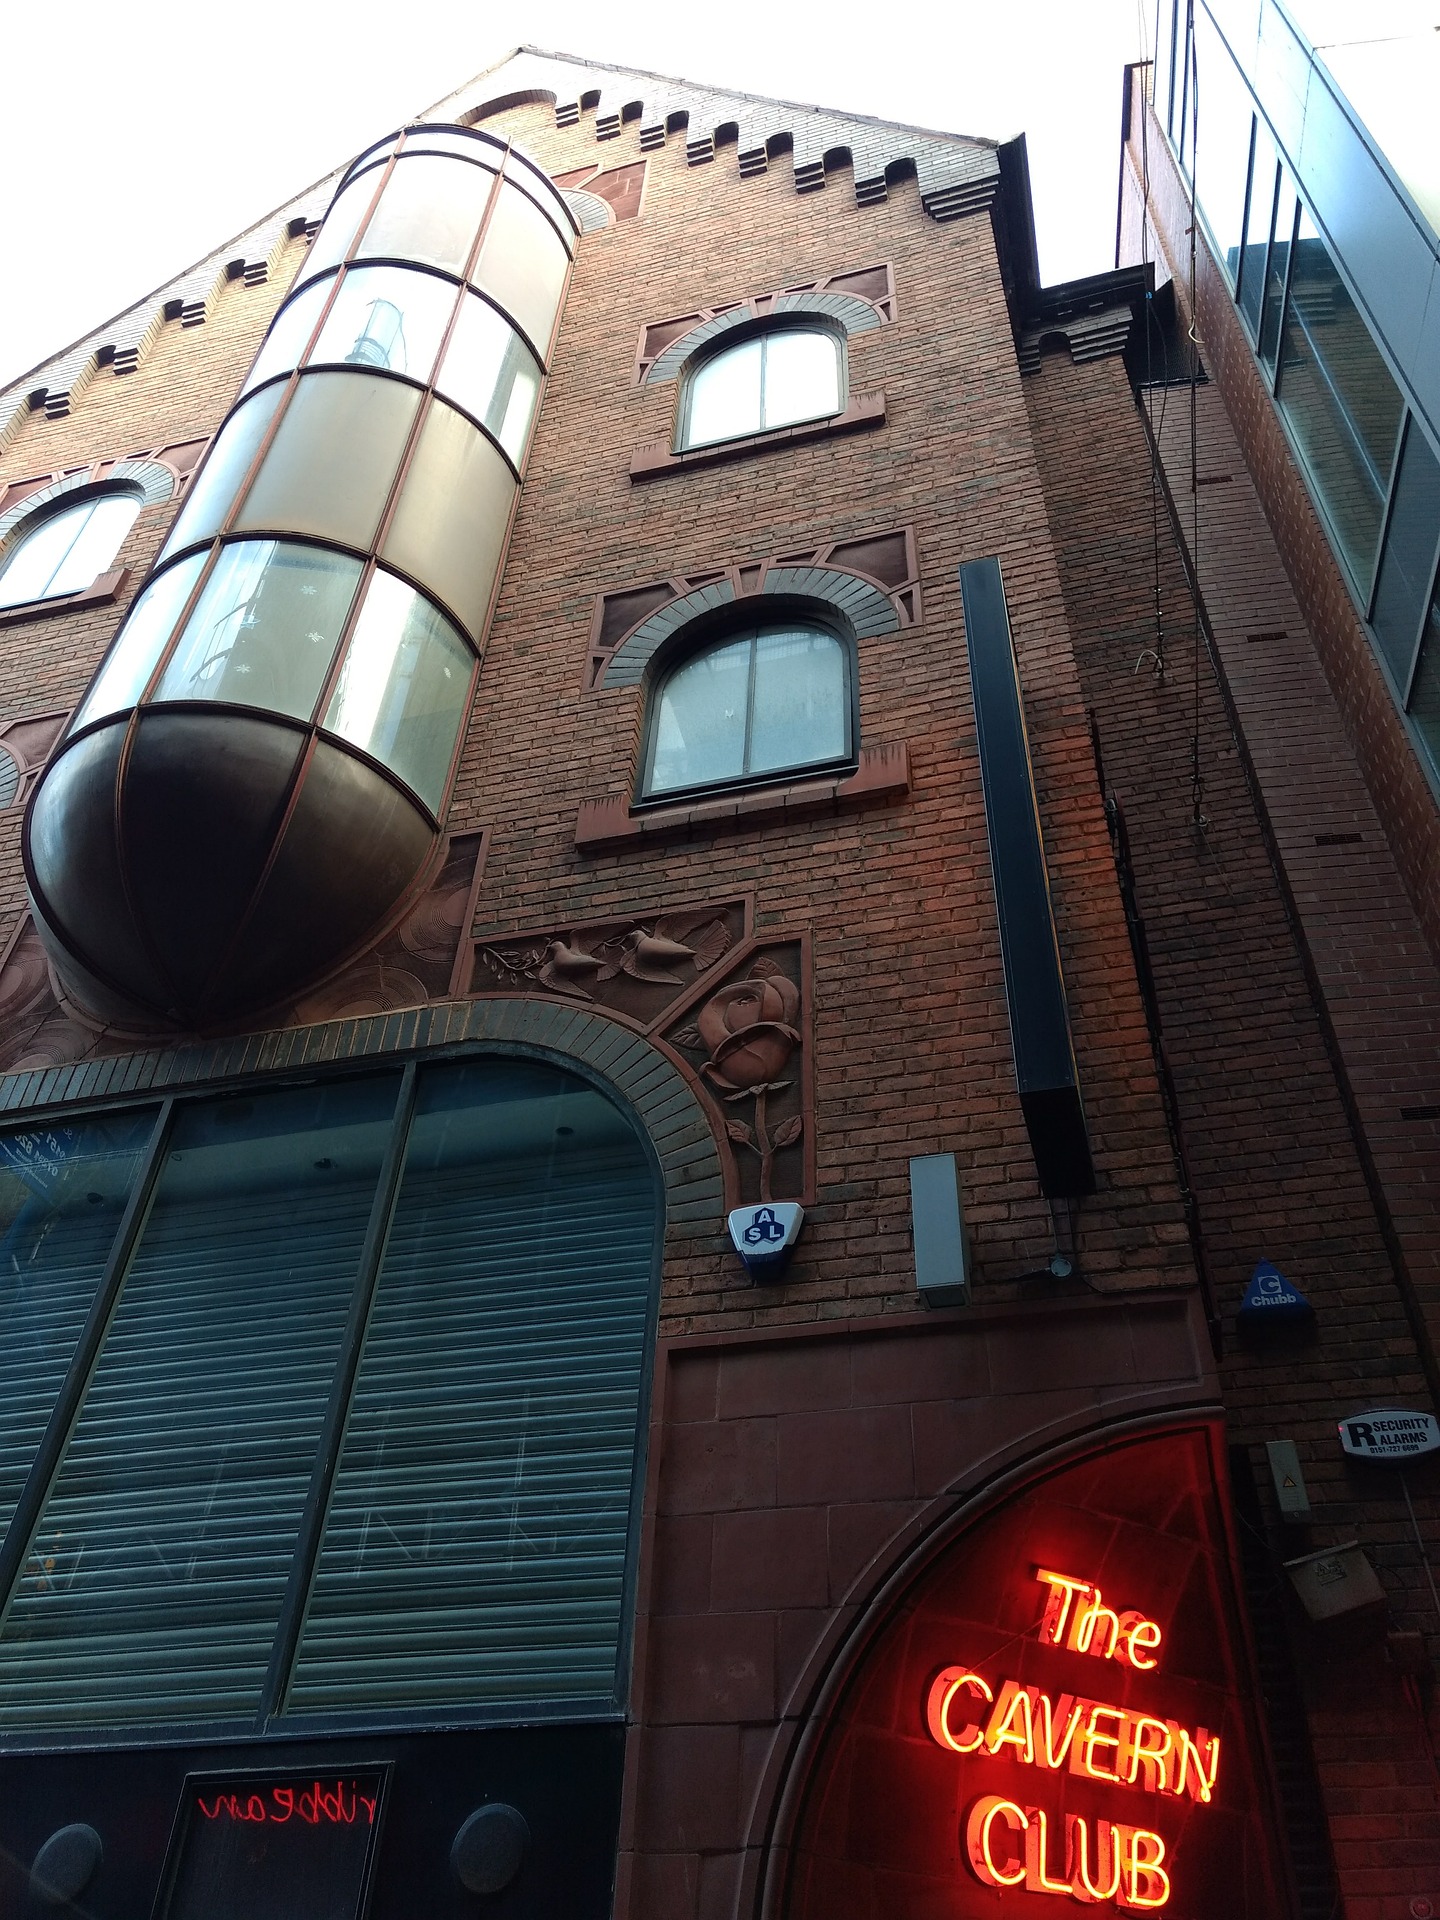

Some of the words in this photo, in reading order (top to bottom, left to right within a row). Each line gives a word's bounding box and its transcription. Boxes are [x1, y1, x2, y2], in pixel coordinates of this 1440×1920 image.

[1251, 1294, 1297, 1307] Chubb
[1346, 1422, 1378, 1447] R
[1372, 1418, 1430, 1432] SECURITY
[1379, 1432, 1428, 1446] ALARMS
[1036, 1568, 1162, 1670] The
[926, 1665, 1220, 1803] CAVERN
[966, 1795, 1171, 1909] CLUB
